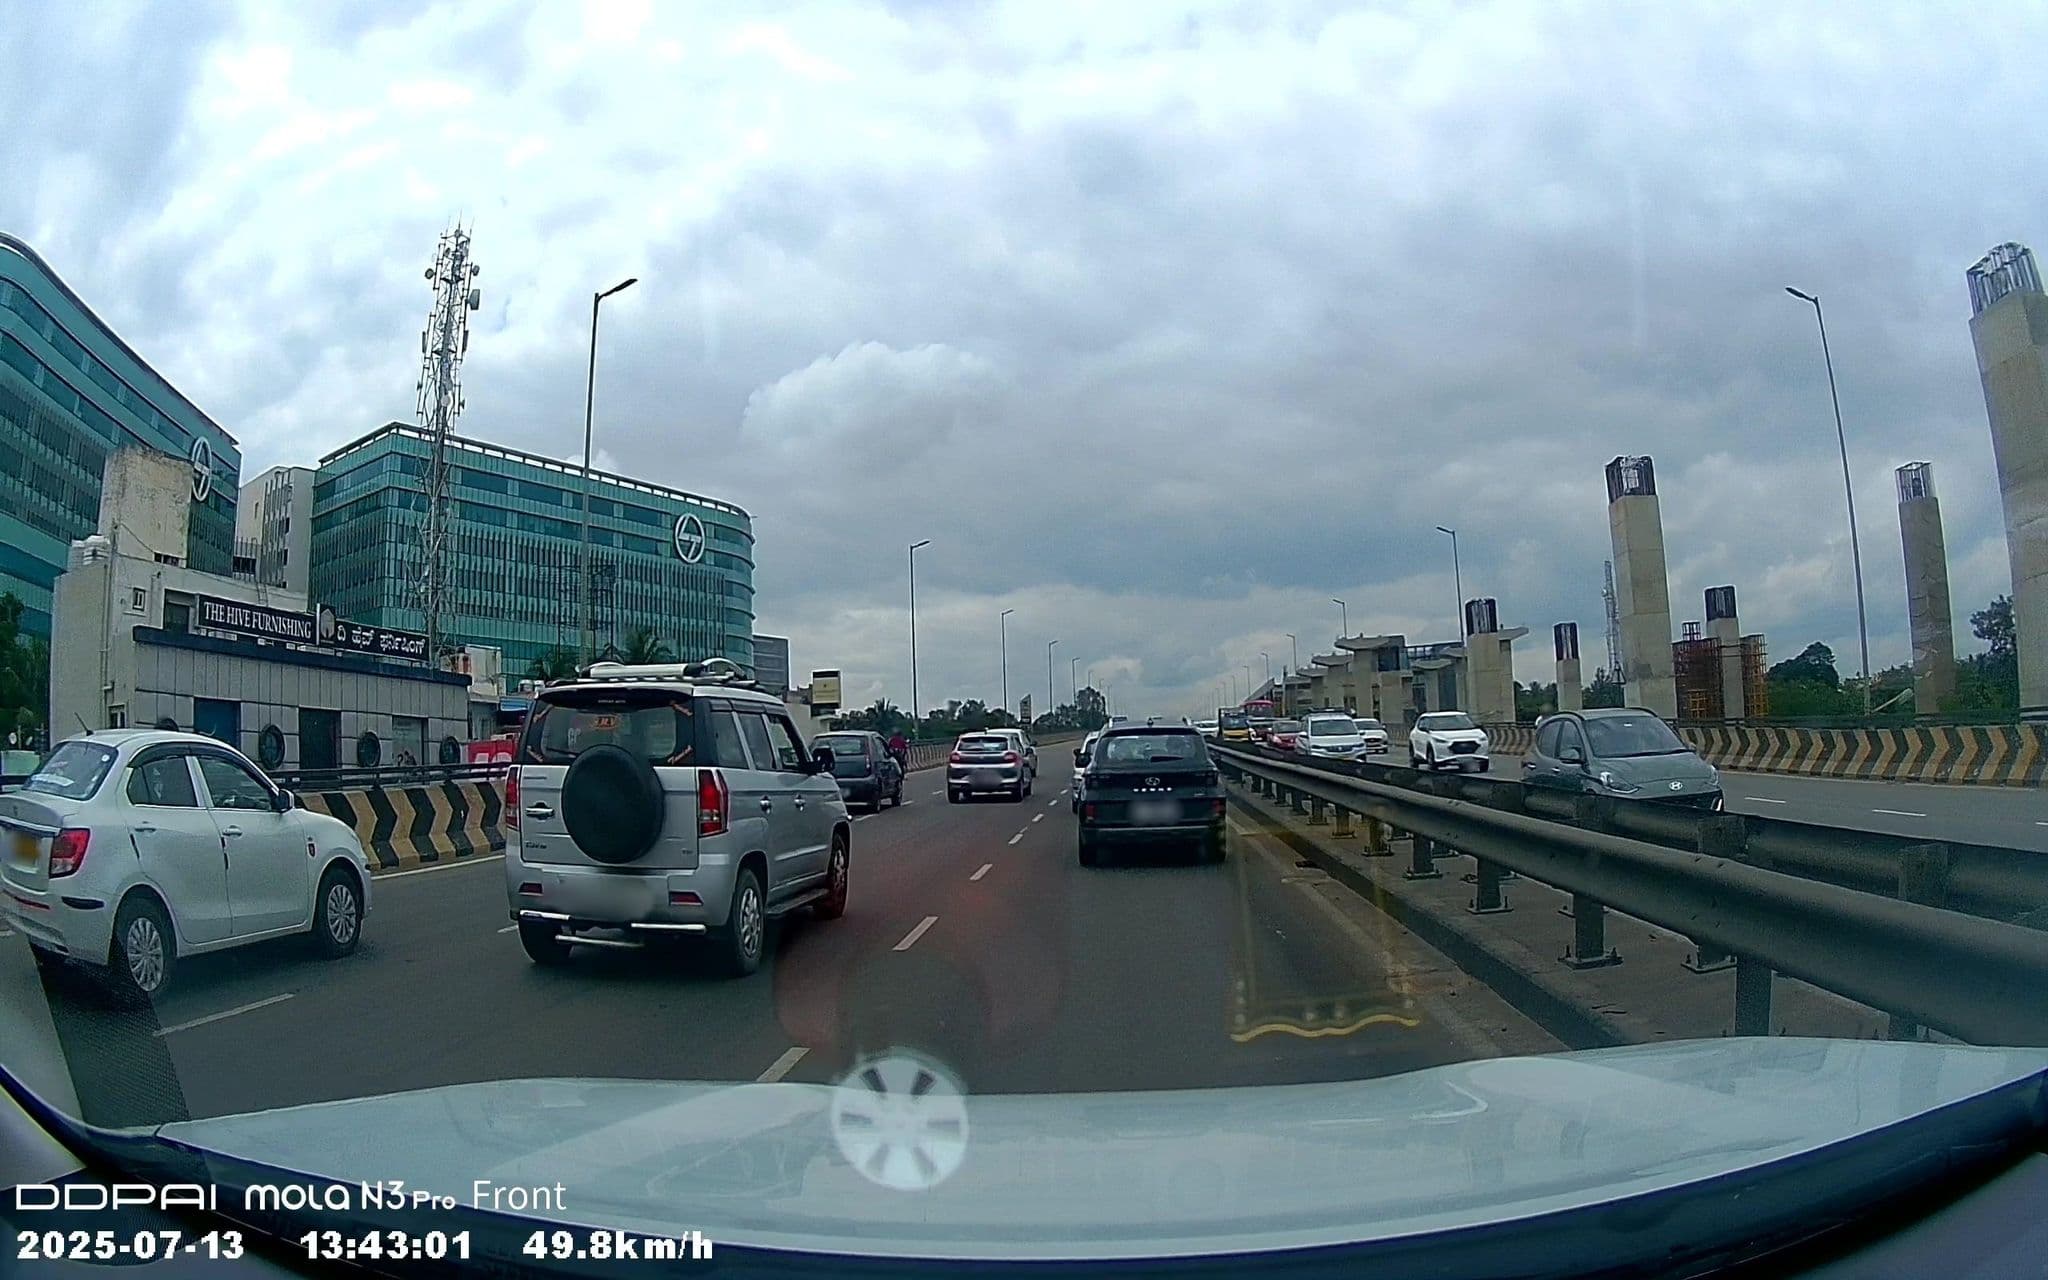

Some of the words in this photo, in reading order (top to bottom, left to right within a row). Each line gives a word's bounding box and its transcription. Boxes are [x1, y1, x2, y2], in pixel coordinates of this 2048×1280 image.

[204, 601, 225, 623] THE
[226, 606, 251, 628] HIVE
[252, 612, 312, 639] FURNISHING
